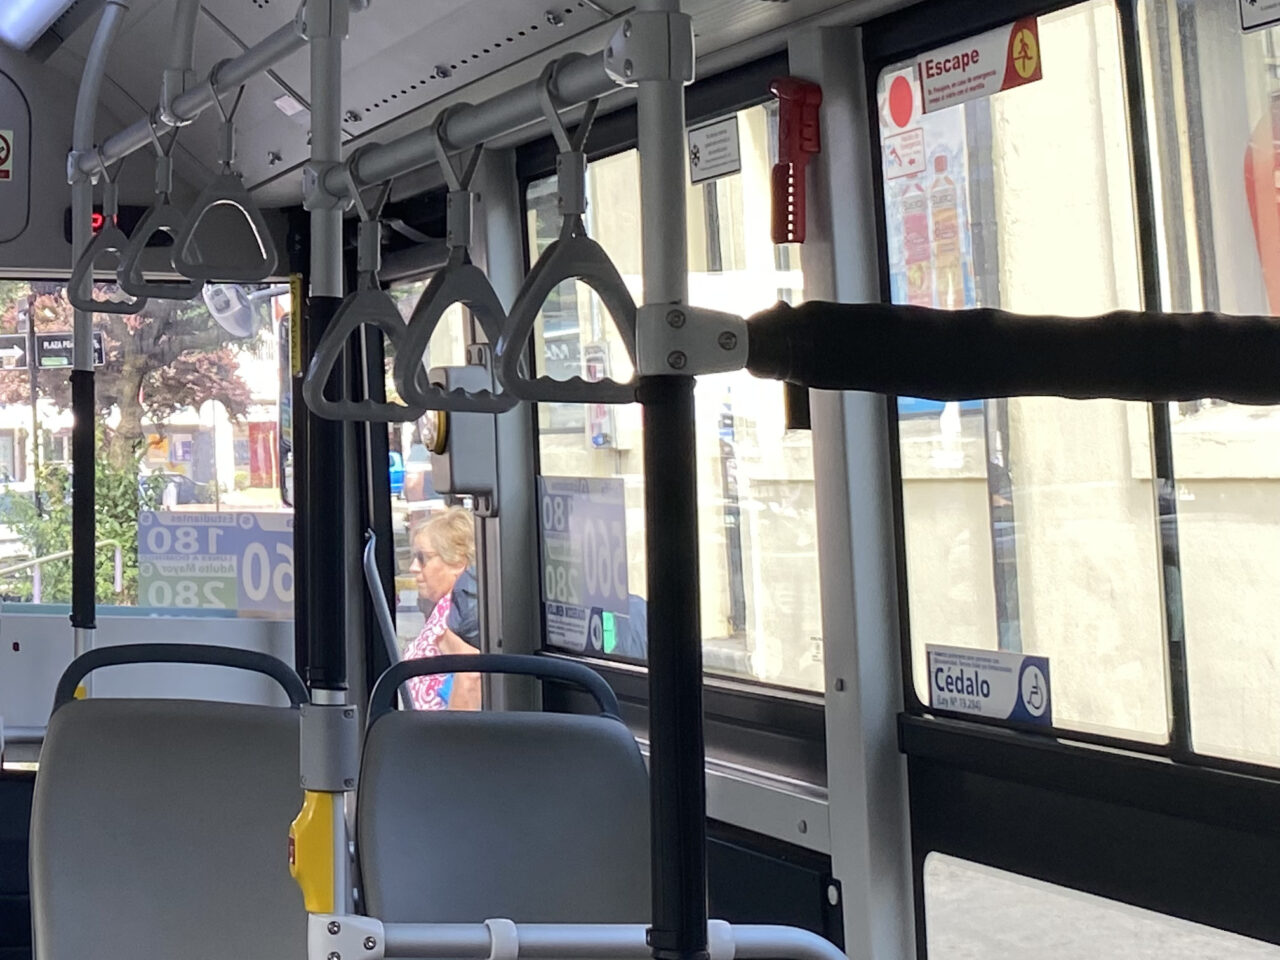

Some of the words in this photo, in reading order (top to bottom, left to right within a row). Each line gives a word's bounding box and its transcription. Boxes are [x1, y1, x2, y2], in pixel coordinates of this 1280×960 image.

[925, 49, 980, 79] Escape
[43, 341, 62, 349] PLAZA
[935, 666, 990, 698] Cédalo
